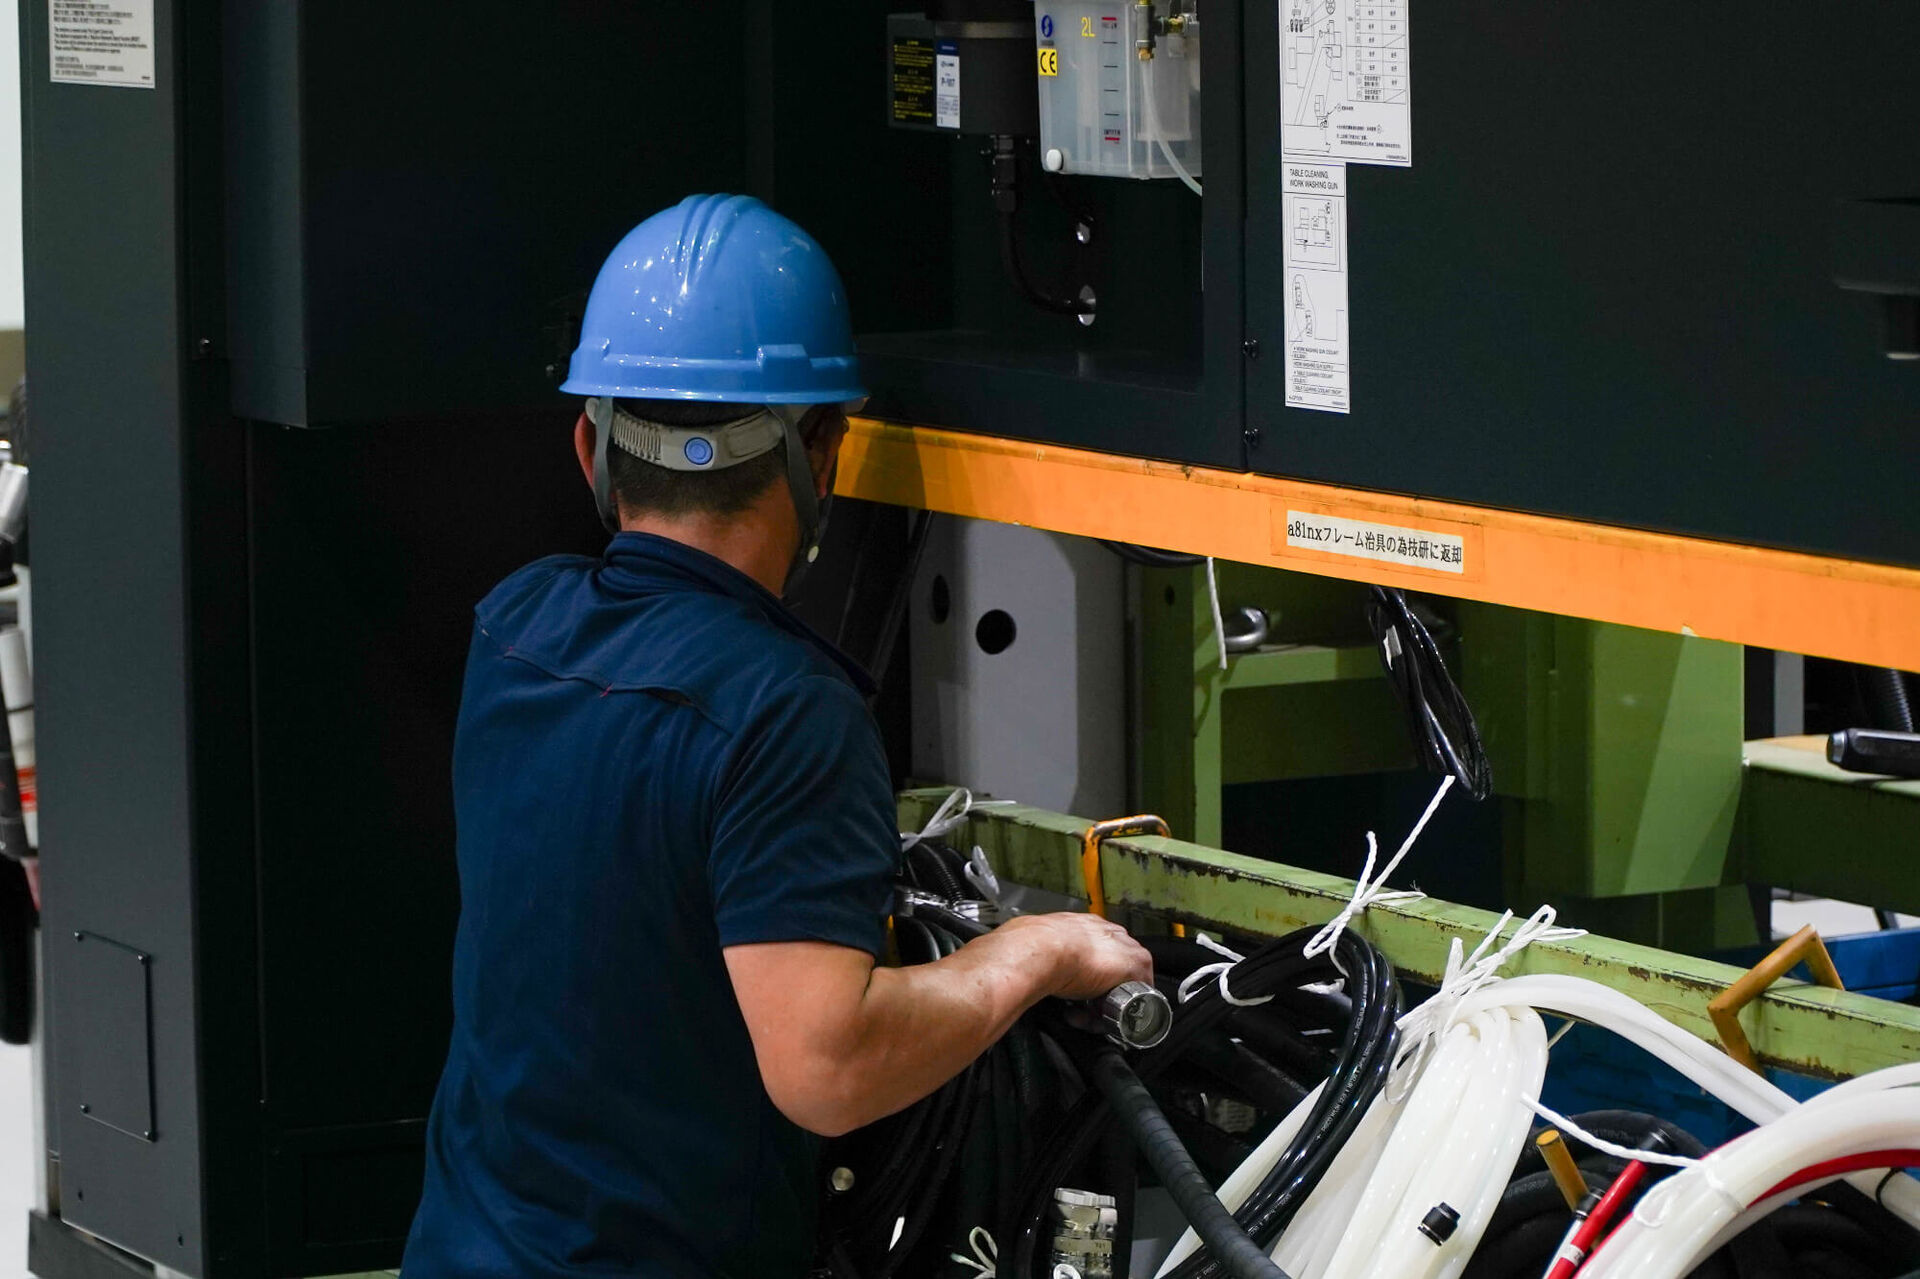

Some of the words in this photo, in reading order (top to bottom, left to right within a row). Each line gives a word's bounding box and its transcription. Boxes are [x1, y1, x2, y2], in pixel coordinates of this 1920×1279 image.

[1081, 16, 1096, 37] 2L
[1040, 51, 1056, 73] CE
[1290, 168, 1304, 178] TABLE
[1290, 179, 1304, 188] WORK
[1304, 180, 1327, 189] WASHING
